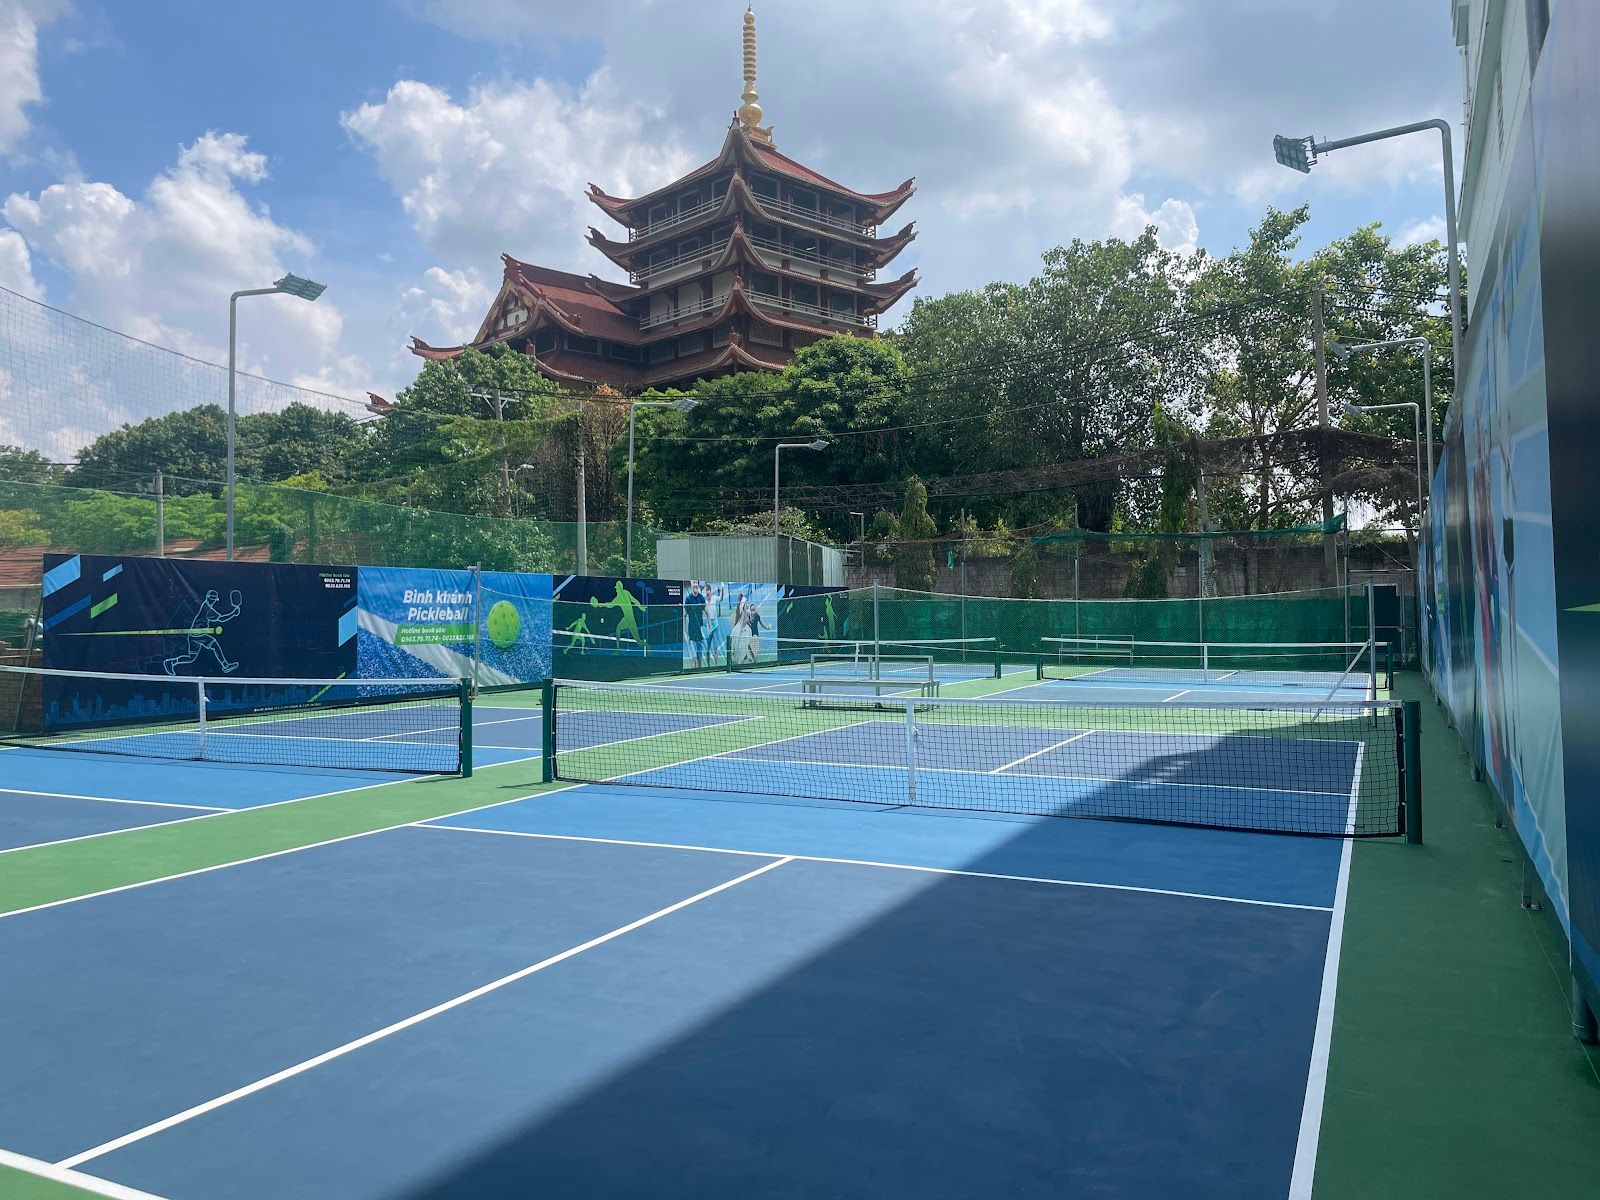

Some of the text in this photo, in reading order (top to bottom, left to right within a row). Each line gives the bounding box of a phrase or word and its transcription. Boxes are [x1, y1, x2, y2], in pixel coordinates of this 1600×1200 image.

[403, 589, 472, 604] Bình khánh
[408, 607, 468, 620] Pickleball
